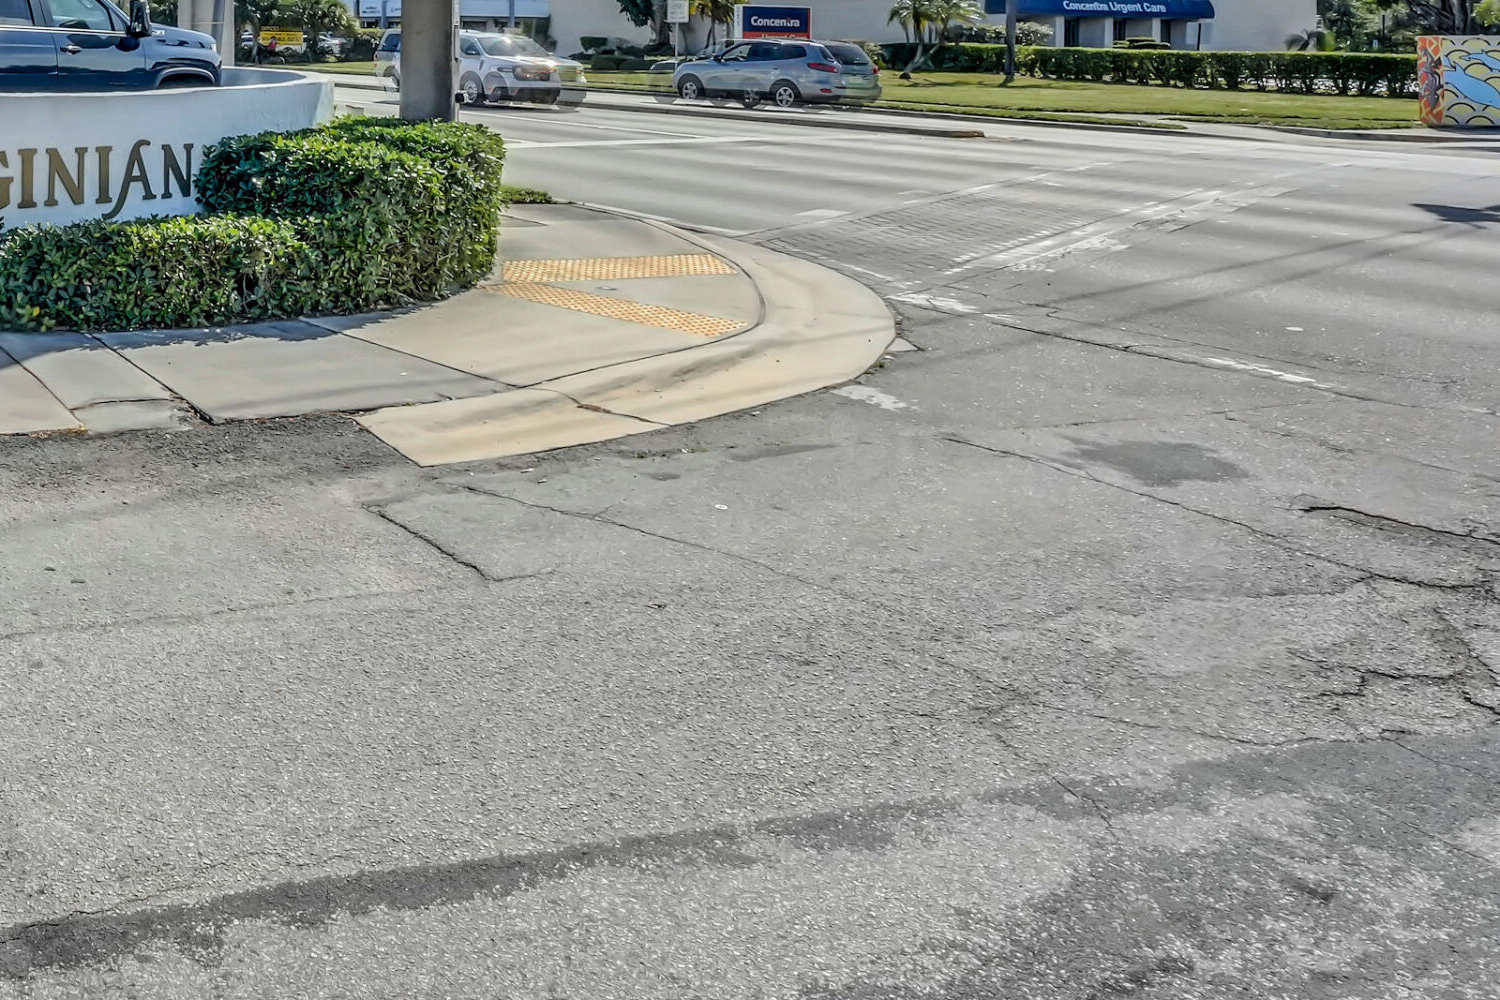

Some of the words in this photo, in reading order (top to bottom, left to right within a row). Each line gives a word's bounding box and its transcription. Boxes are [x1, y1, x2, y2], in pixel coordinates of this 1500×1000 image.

[1063, 0, 1109, 12] Concentra
[1109, 1, 1142, 14] Urgent
[1143, 2, 1166, 13] Care
[750, 15, 800, 28] Concentra
